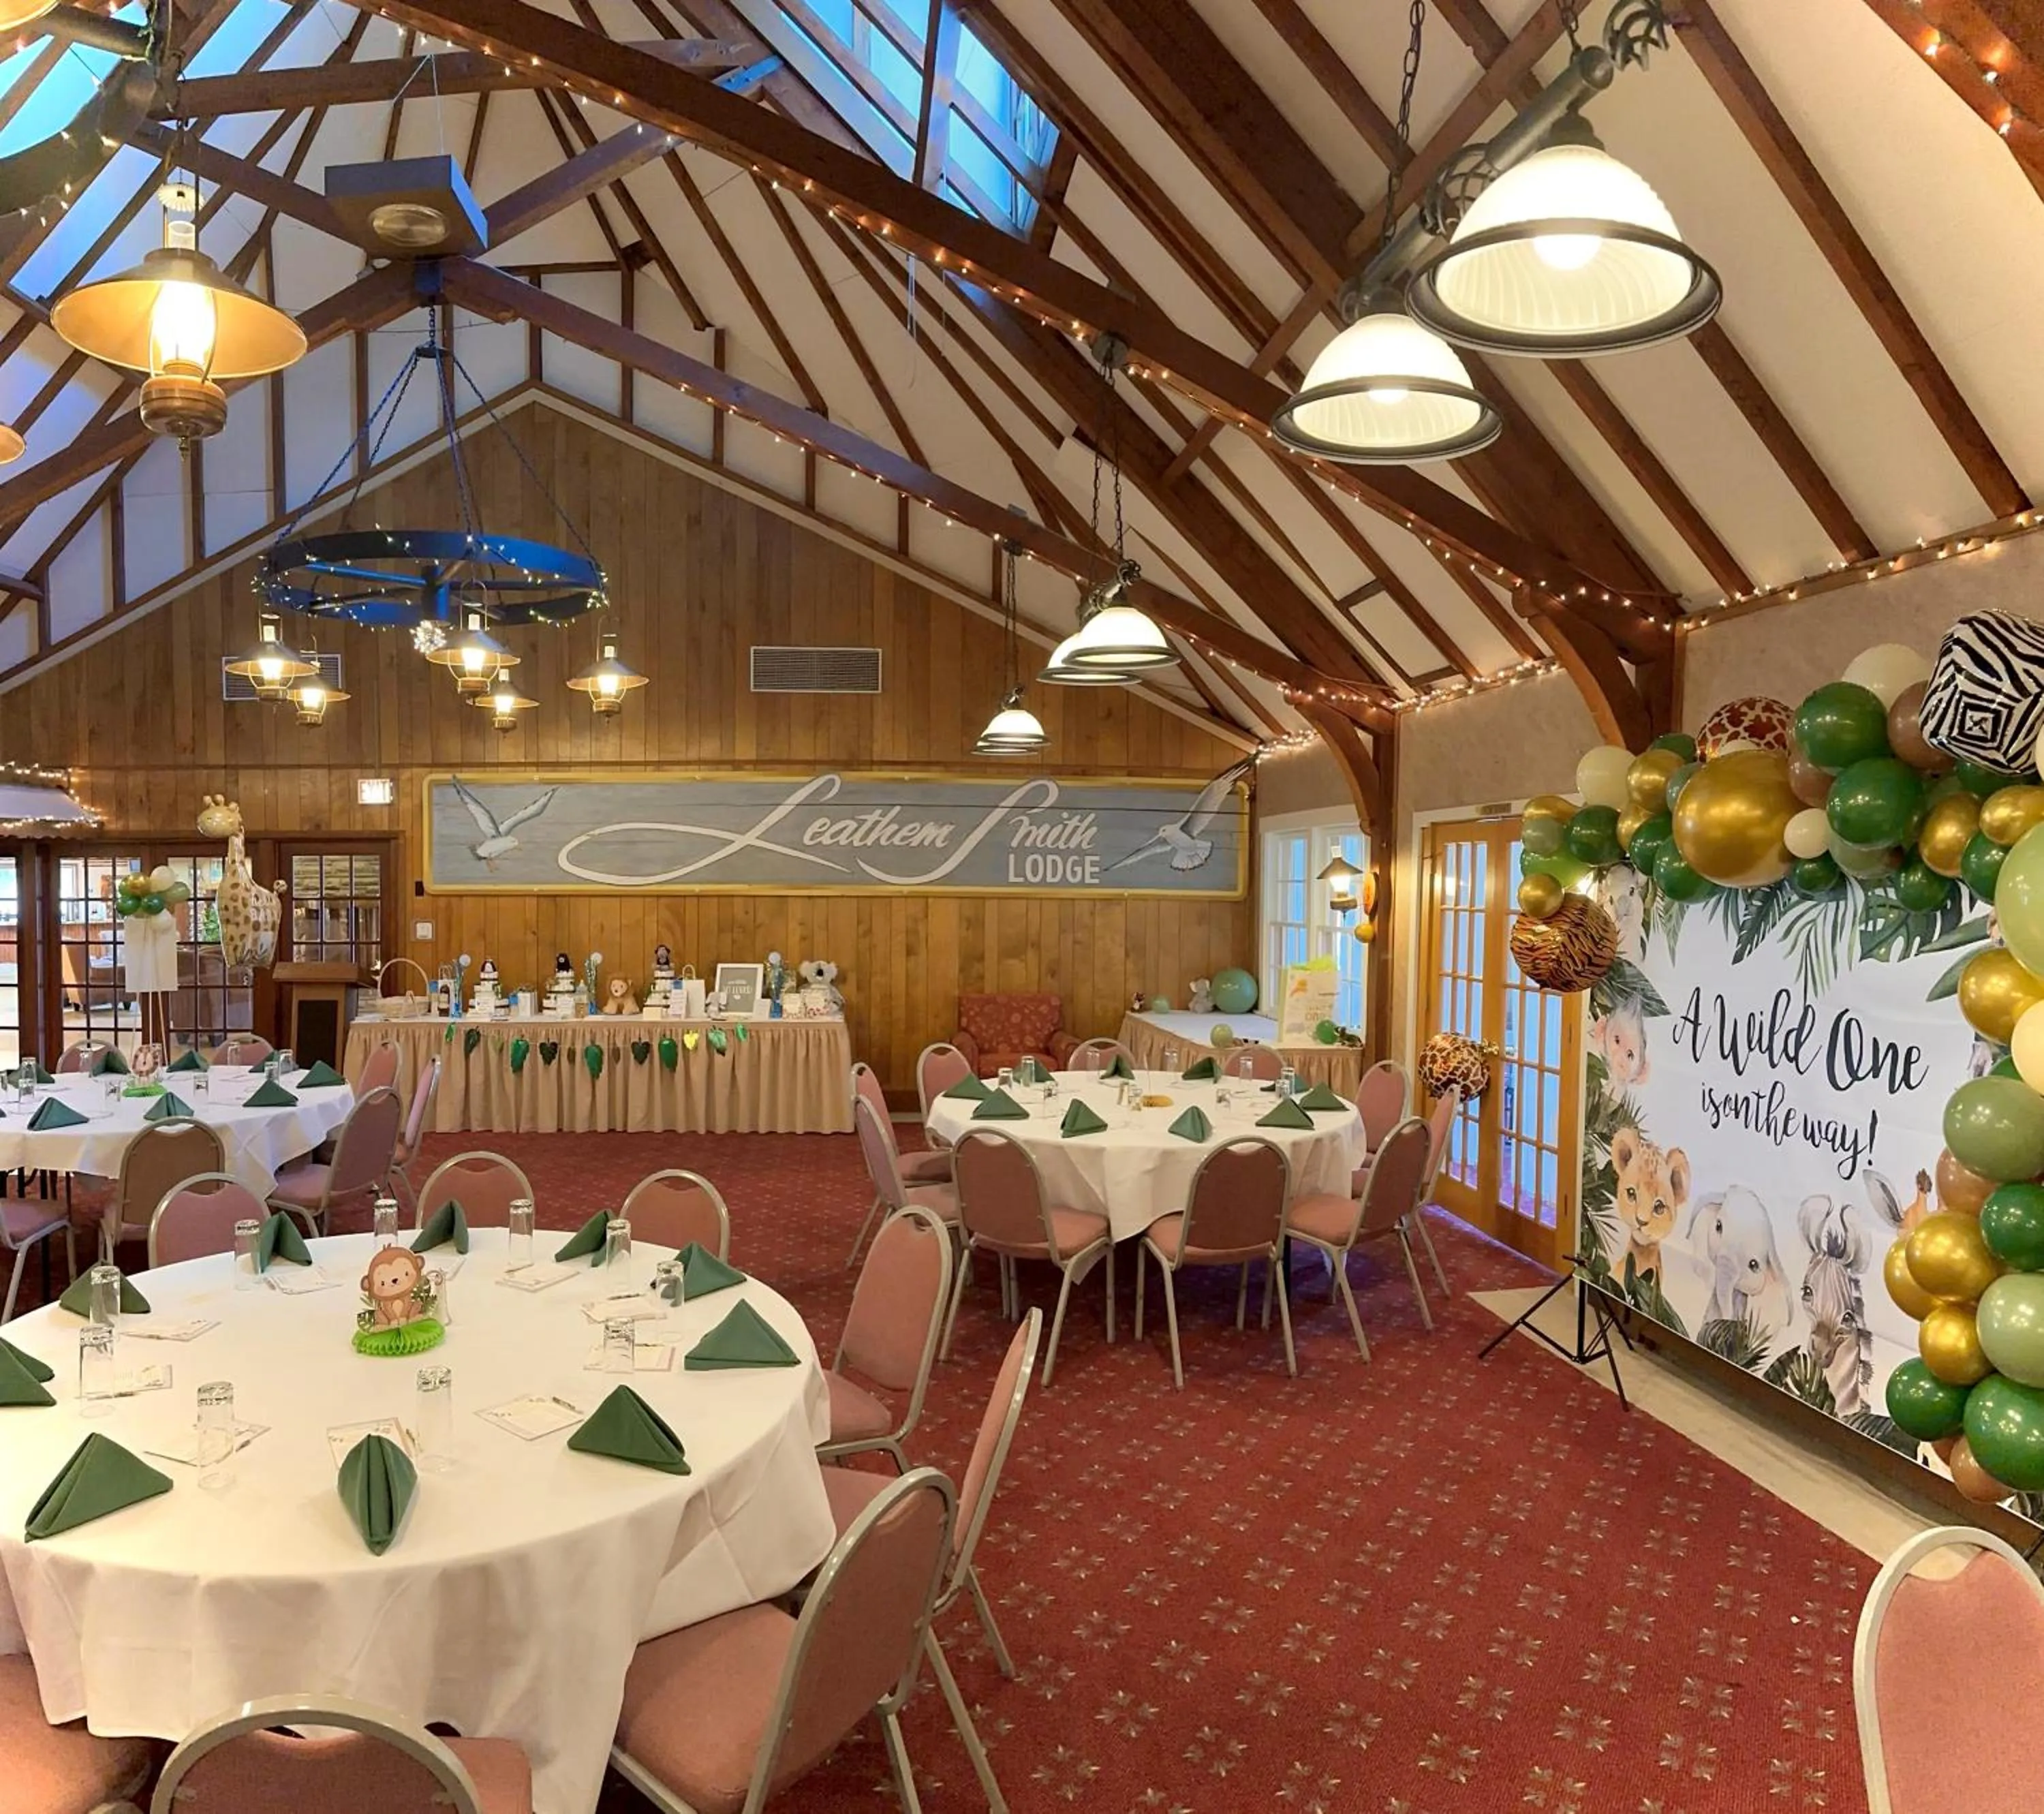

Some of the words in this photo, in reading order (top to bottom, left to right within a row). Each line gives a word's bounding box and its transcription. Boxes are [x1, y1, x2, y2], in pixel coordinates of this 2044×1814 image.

[558, 773, 956, 885] Leathem
[856, 779, 1098, 885] Smith
[1008, 853, 1101, 884] LODGE
[1673, 986, 1712, 1063] A
[1714, 988, 1823, 1077] Wild
[1826, 1008, 1930, 1094] One
[1803, 1109, 1878, 1180] way!
